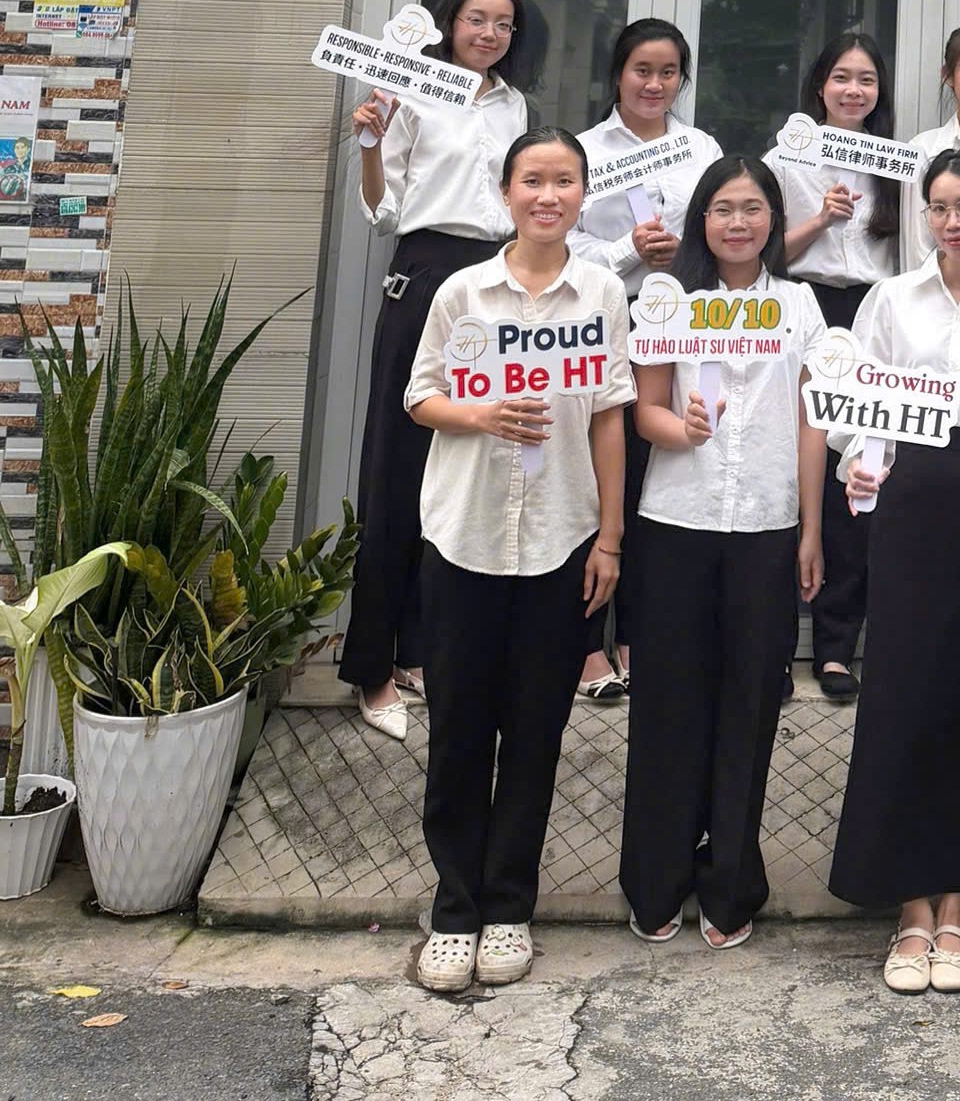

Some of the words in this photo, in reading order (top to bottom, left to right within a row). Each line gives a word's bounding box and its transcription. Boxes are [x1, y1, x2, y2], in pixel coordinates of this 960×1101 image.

[327, 32, 379, 59] RESPONSIBLE
[383, 52, 431, 75] RESPONSIVE
[437, 70, 474, 90] RELIABLE
[590, 167, 607, 178] TAX
[606, 162, 616, 174] &
[616, 146, 659, 170] ACCOUNTING
[821, 144, 915, 177] 弘信律师事务所
[823, 132, 857, 146] HOANG
[860, 140, 873, 150] TIN
[876, 143, 895, 155] LAW
[898, 148, 918, 160] FIRM
[690, 298, 781, 329] 10/10
[499, 316, 603, 354] Proud
[635, 339, 650, 357] TỰ
[652, 337, 675, 354] HÀO
[679, 337, 707, 357] LUẬT
[710, 339, 726, 354] SƯ
[727, 337, 752, 357] VIỆT
[756, 339, 781, 354] NAM
[452, 367, 490, 398] To
[505, 363, 550, 394] Be
[563, 354, 607, 388] HT
[856, 363, 956, 402] Growing
[810, 390, 890, 431] With
[897, 404, 951, 438] HT
